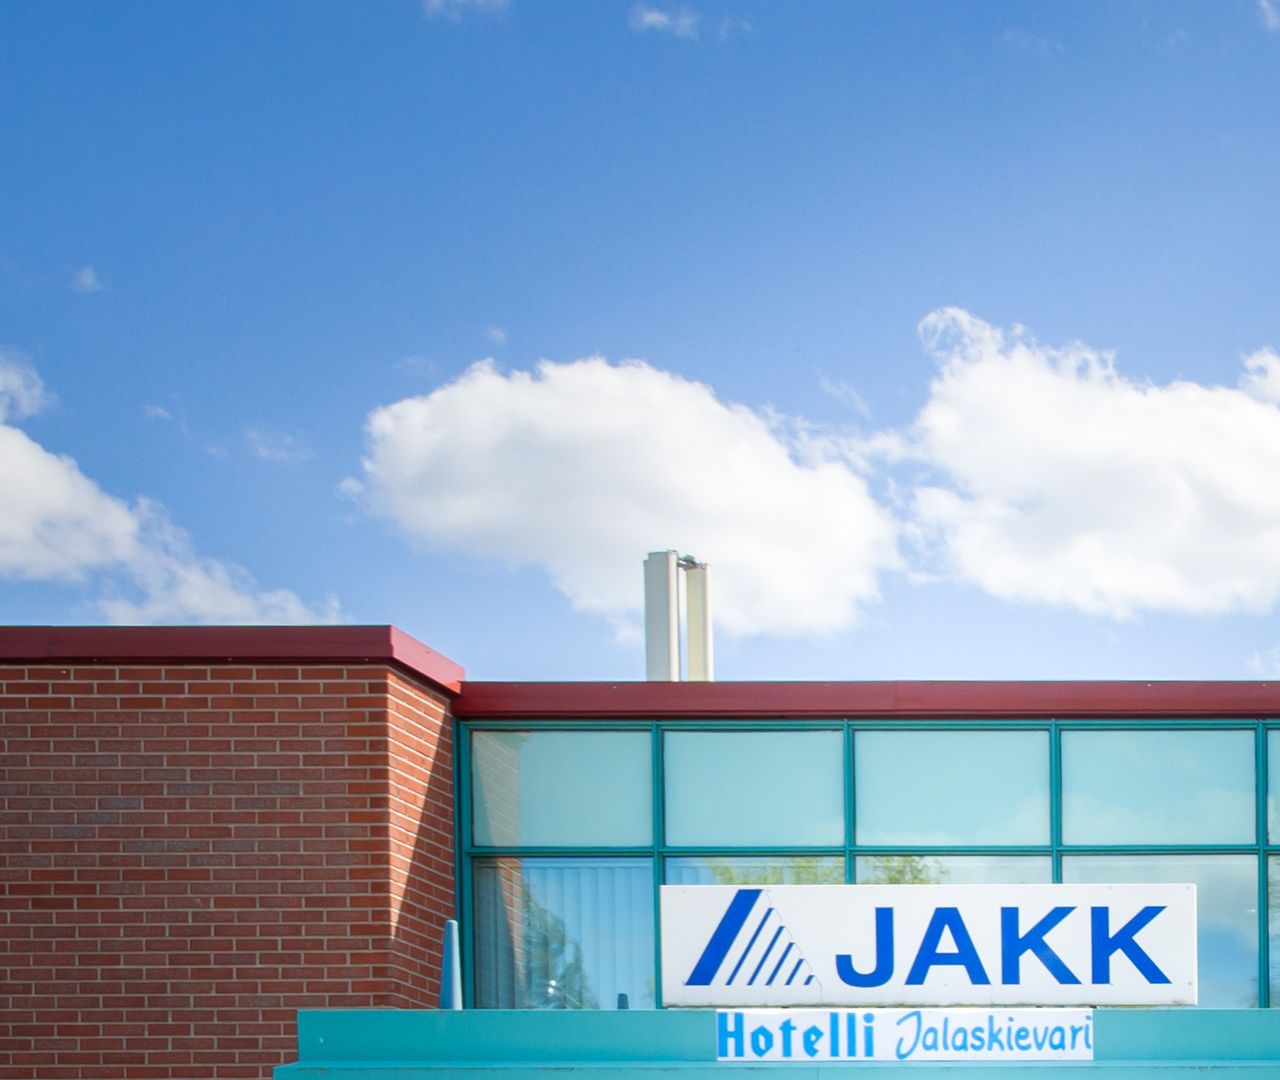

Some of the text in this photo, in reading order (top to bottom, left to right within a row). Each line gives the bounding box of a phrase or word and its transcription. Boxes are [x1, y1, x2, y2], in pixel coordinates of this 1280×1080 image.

[835, 906, 1173, 987] JAKK
[717, 1011, 1093, 1059] Hotelli Jalaskievari
